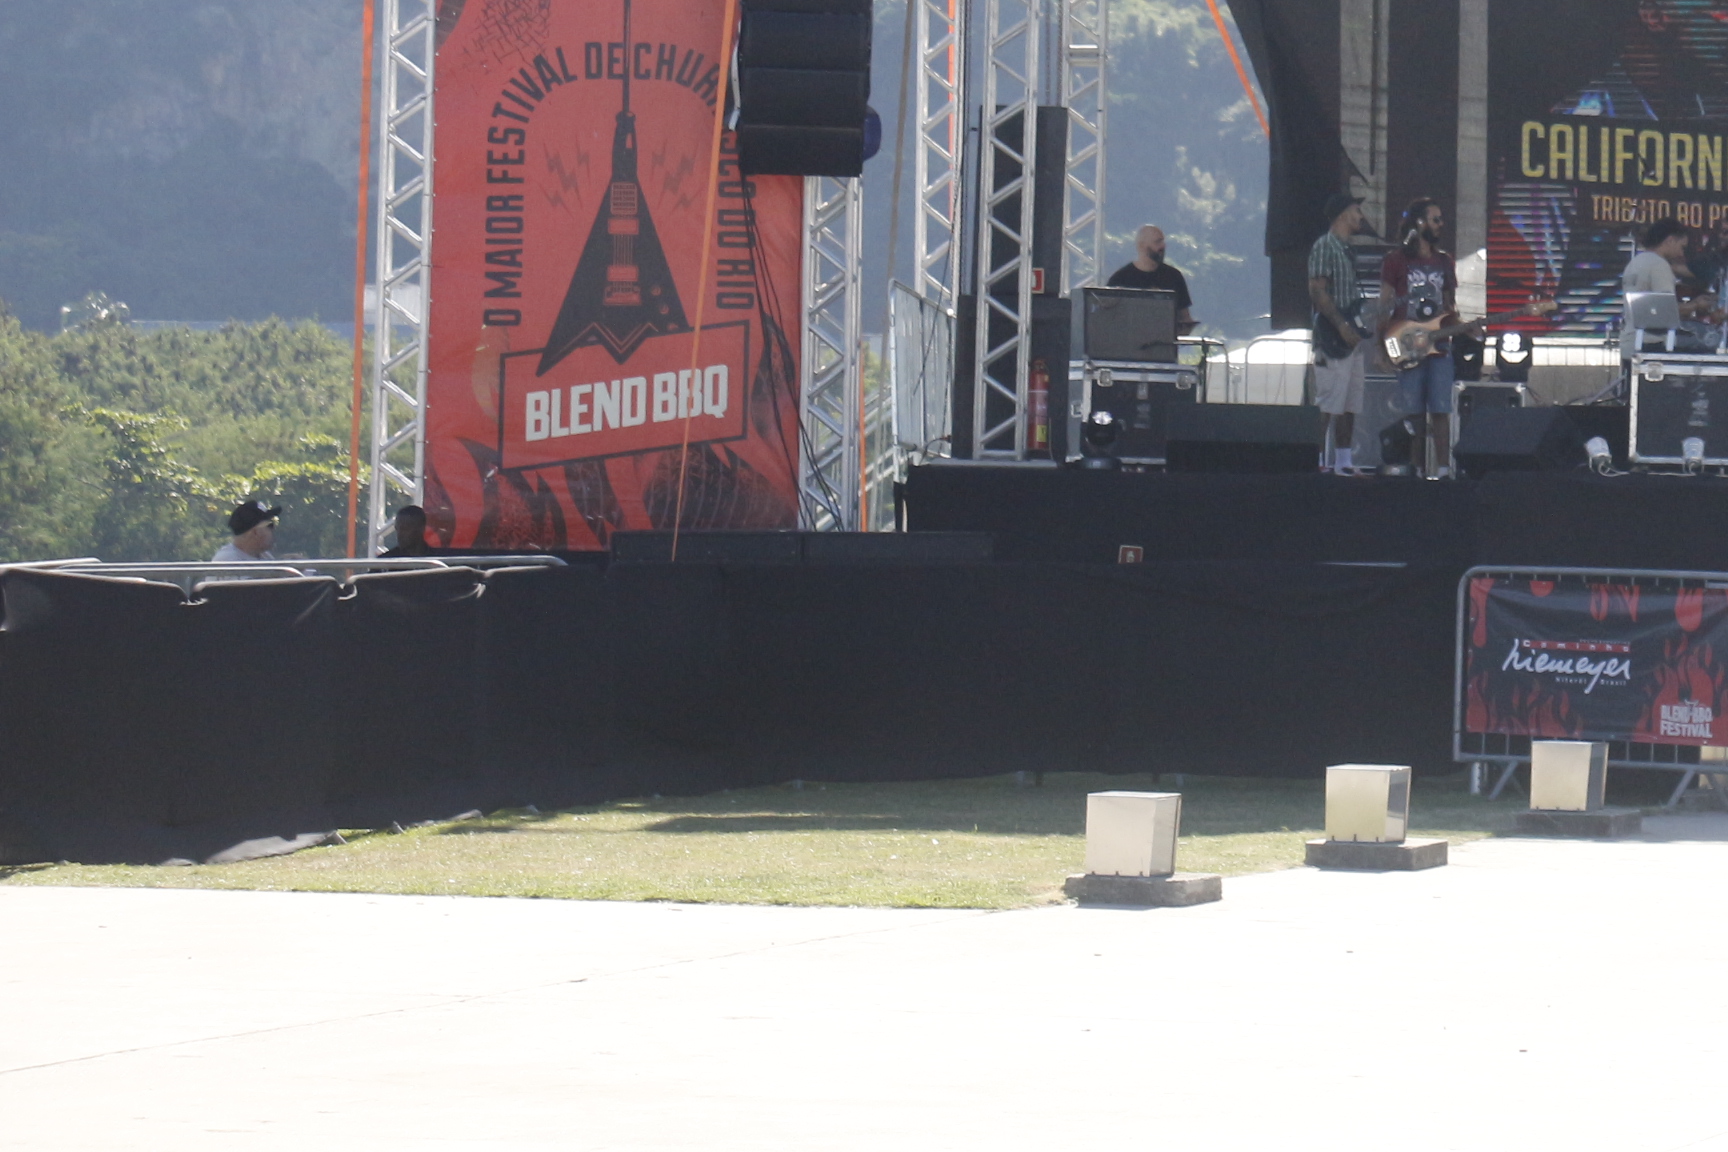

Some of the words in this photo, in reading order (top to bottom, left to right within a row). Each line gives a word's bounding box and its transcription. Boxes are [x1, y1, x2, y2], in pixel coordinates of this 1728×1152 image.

[584, 42, 625, 80] DE
[486, 46, 578, 184] FESTIVAL
[484, 194, 524, 298] MAIOR
[716, 208, 756, 248] DO
[716, 258, 756, 310] RIO
[483, 308, 522, 327] O
[526, 376, 647, 442] BLEND
[653, 364, 728, 423] BBQ
[1661, 720, 1713, 738] FESTIVAL
